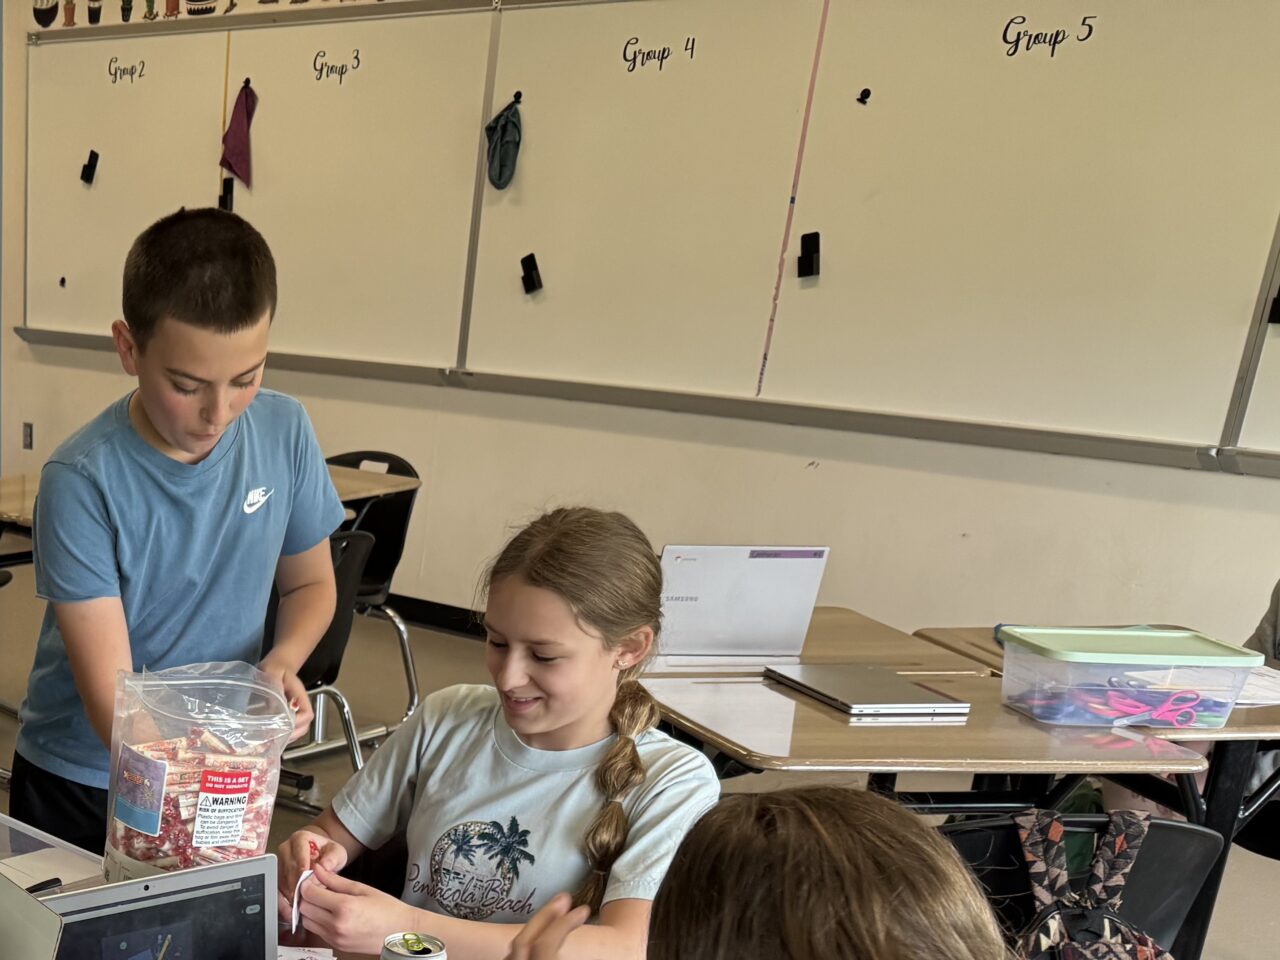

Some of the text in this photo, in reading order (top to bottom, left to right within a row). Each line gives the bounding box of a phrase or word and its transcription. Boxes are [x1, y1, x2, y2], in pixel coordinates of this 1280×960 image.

[1001, 15, 1098, 58] Group 5
[108, 57, 146, 84] Group 2
[313, 48, 361, 85] Group 3
[622, 37, 696, 72] Group 4
[207, 775, 223, 783] THIS
[212, 796, 247, 806] WARNING
[407, 863, 537, 915] Pensacola Beach
